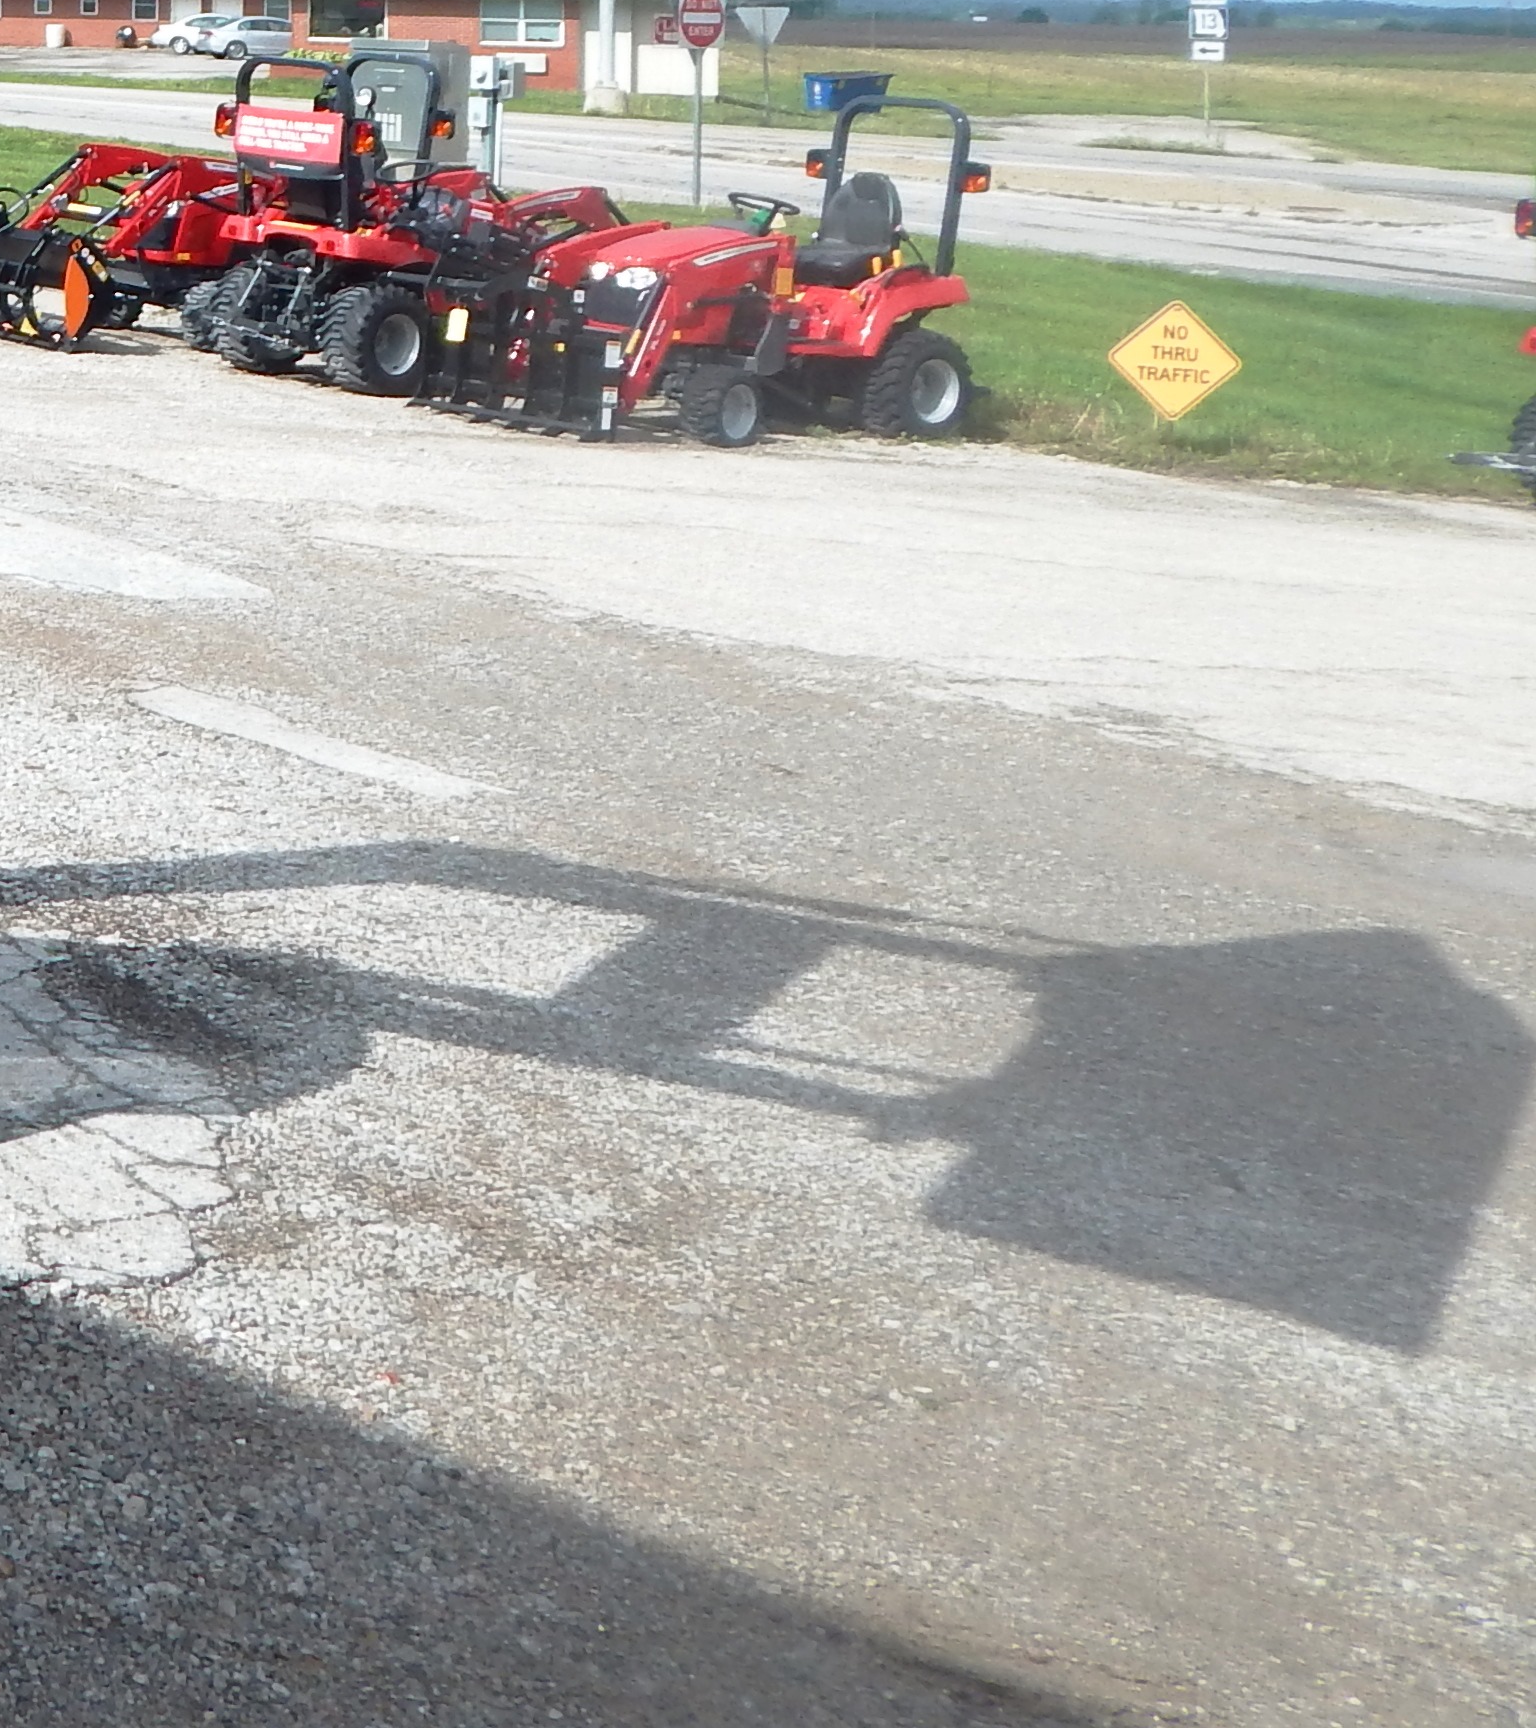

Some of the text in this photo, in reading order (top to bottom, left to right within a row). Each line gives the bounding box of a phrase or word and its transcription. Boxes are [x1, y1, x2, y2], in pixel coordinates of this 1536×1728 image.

[1201, 13, 1217, 30] 13
[1163, 324, 1189, 340] NO
[1151, 345, 1199, 362] THRU
[1137, 365, 1211, 385] TRAFFIC
